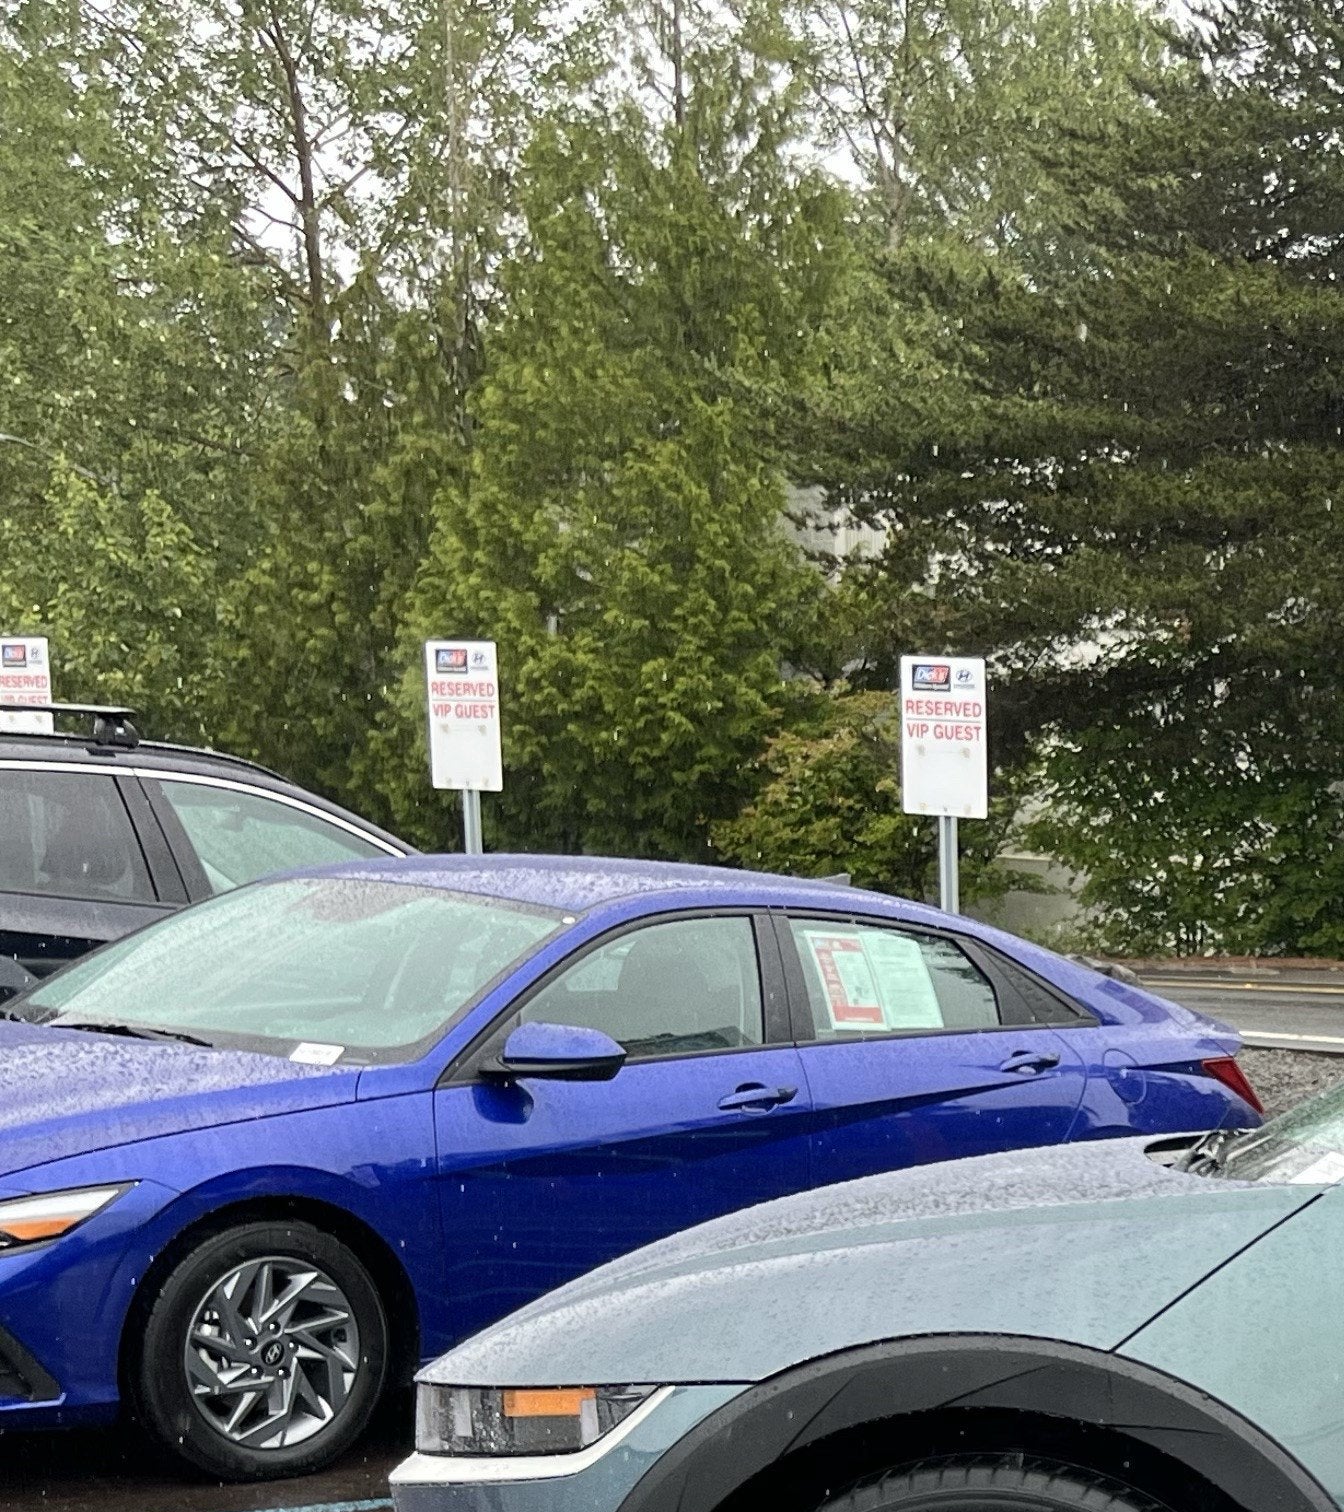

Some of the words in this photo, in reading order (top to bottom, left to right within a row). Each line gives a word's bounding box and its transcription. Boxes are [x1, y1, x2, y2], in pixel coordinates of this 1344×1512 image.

[431, 680, 496, 698] RESERVED
[432, 703, 452, 717] VIP
[454, 703, 496, 719] GUEST
[905, 699, 983, 718] RESERVED
[906, 722, 929, 739] VIP
[933, 723, 982, 742] GUEST
